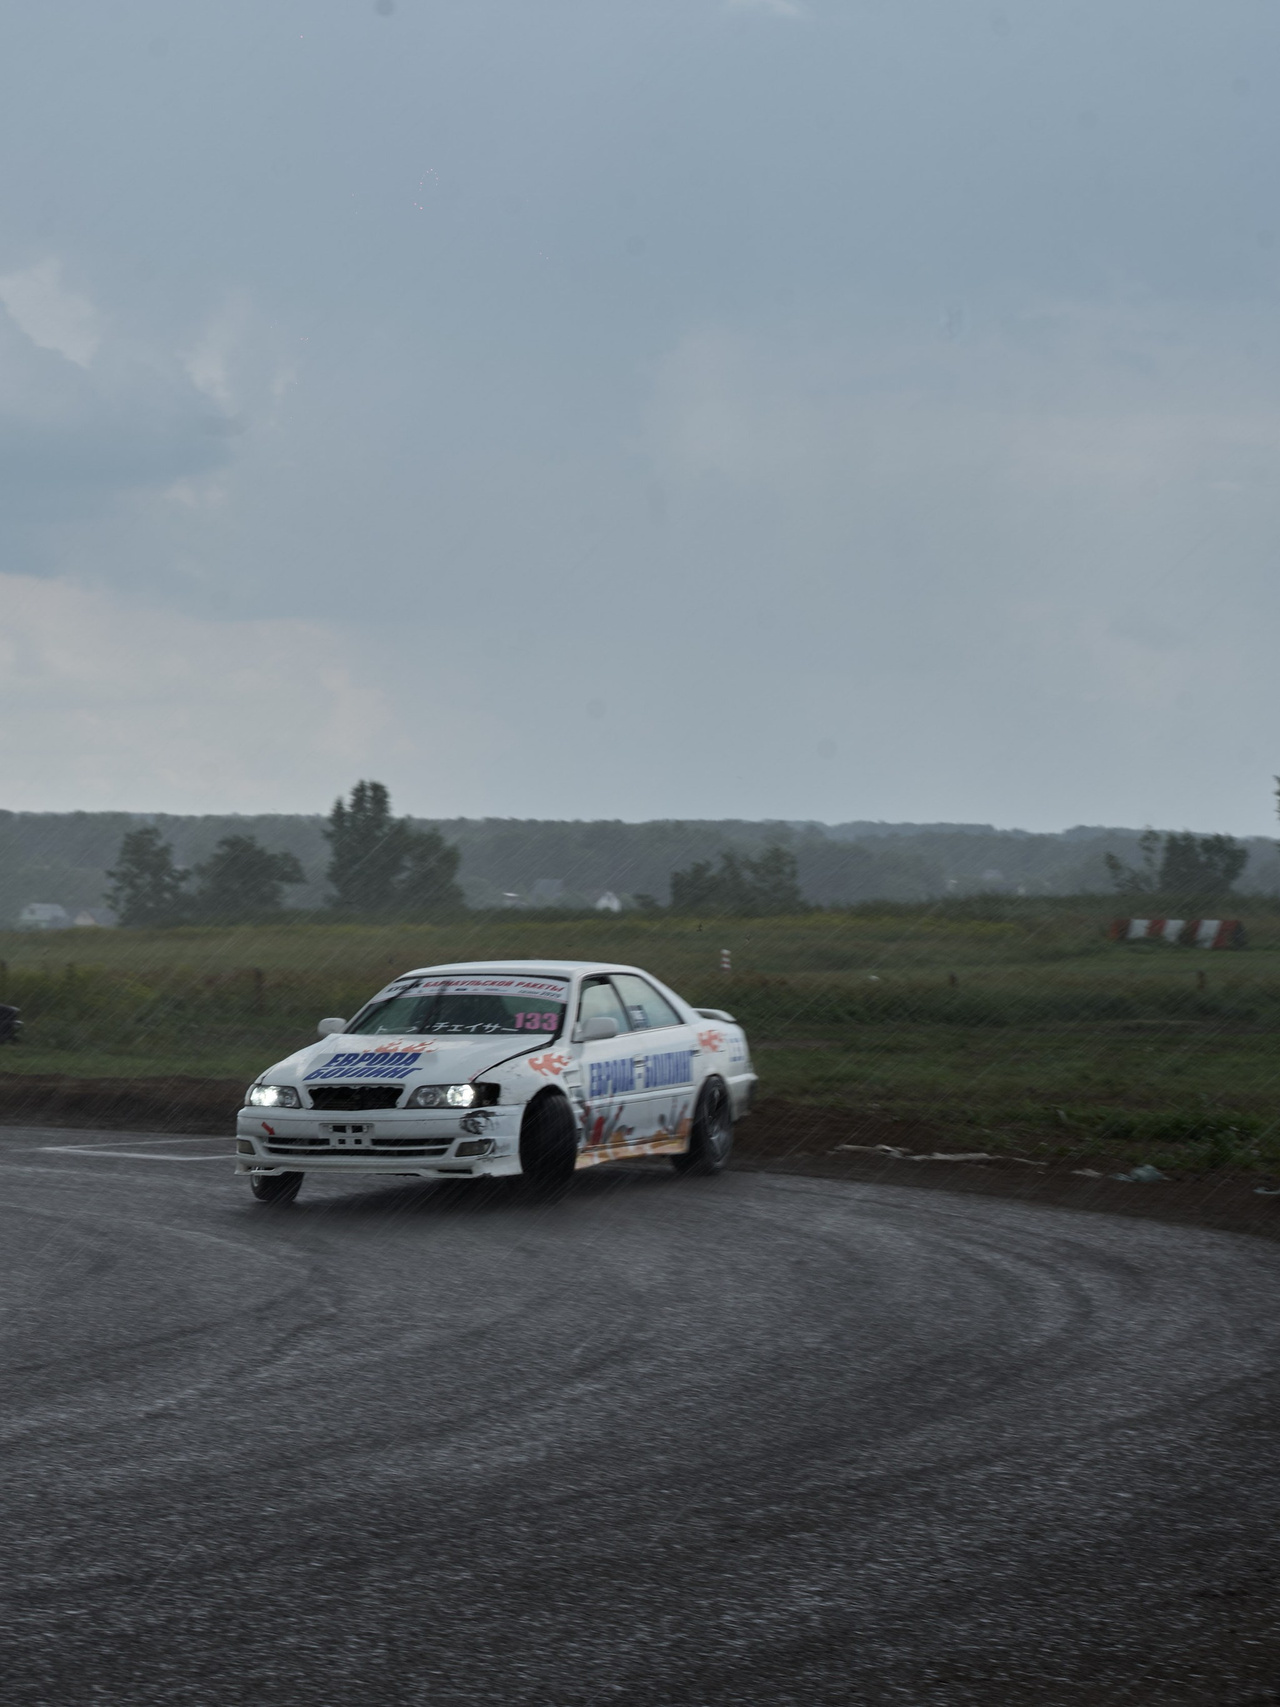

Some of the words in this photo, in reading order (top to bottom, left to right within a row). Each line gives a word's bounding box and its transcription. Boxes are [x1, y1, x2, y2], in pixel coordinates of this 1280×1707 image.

[515, 981, 565, 992] РАКЕТЫ
[515, 1012, 558, 1031] 133
[322, 1052, 423, 1068] ЕВРОПА
[302, 1067, 424, 1082] БОУЛИНГ
